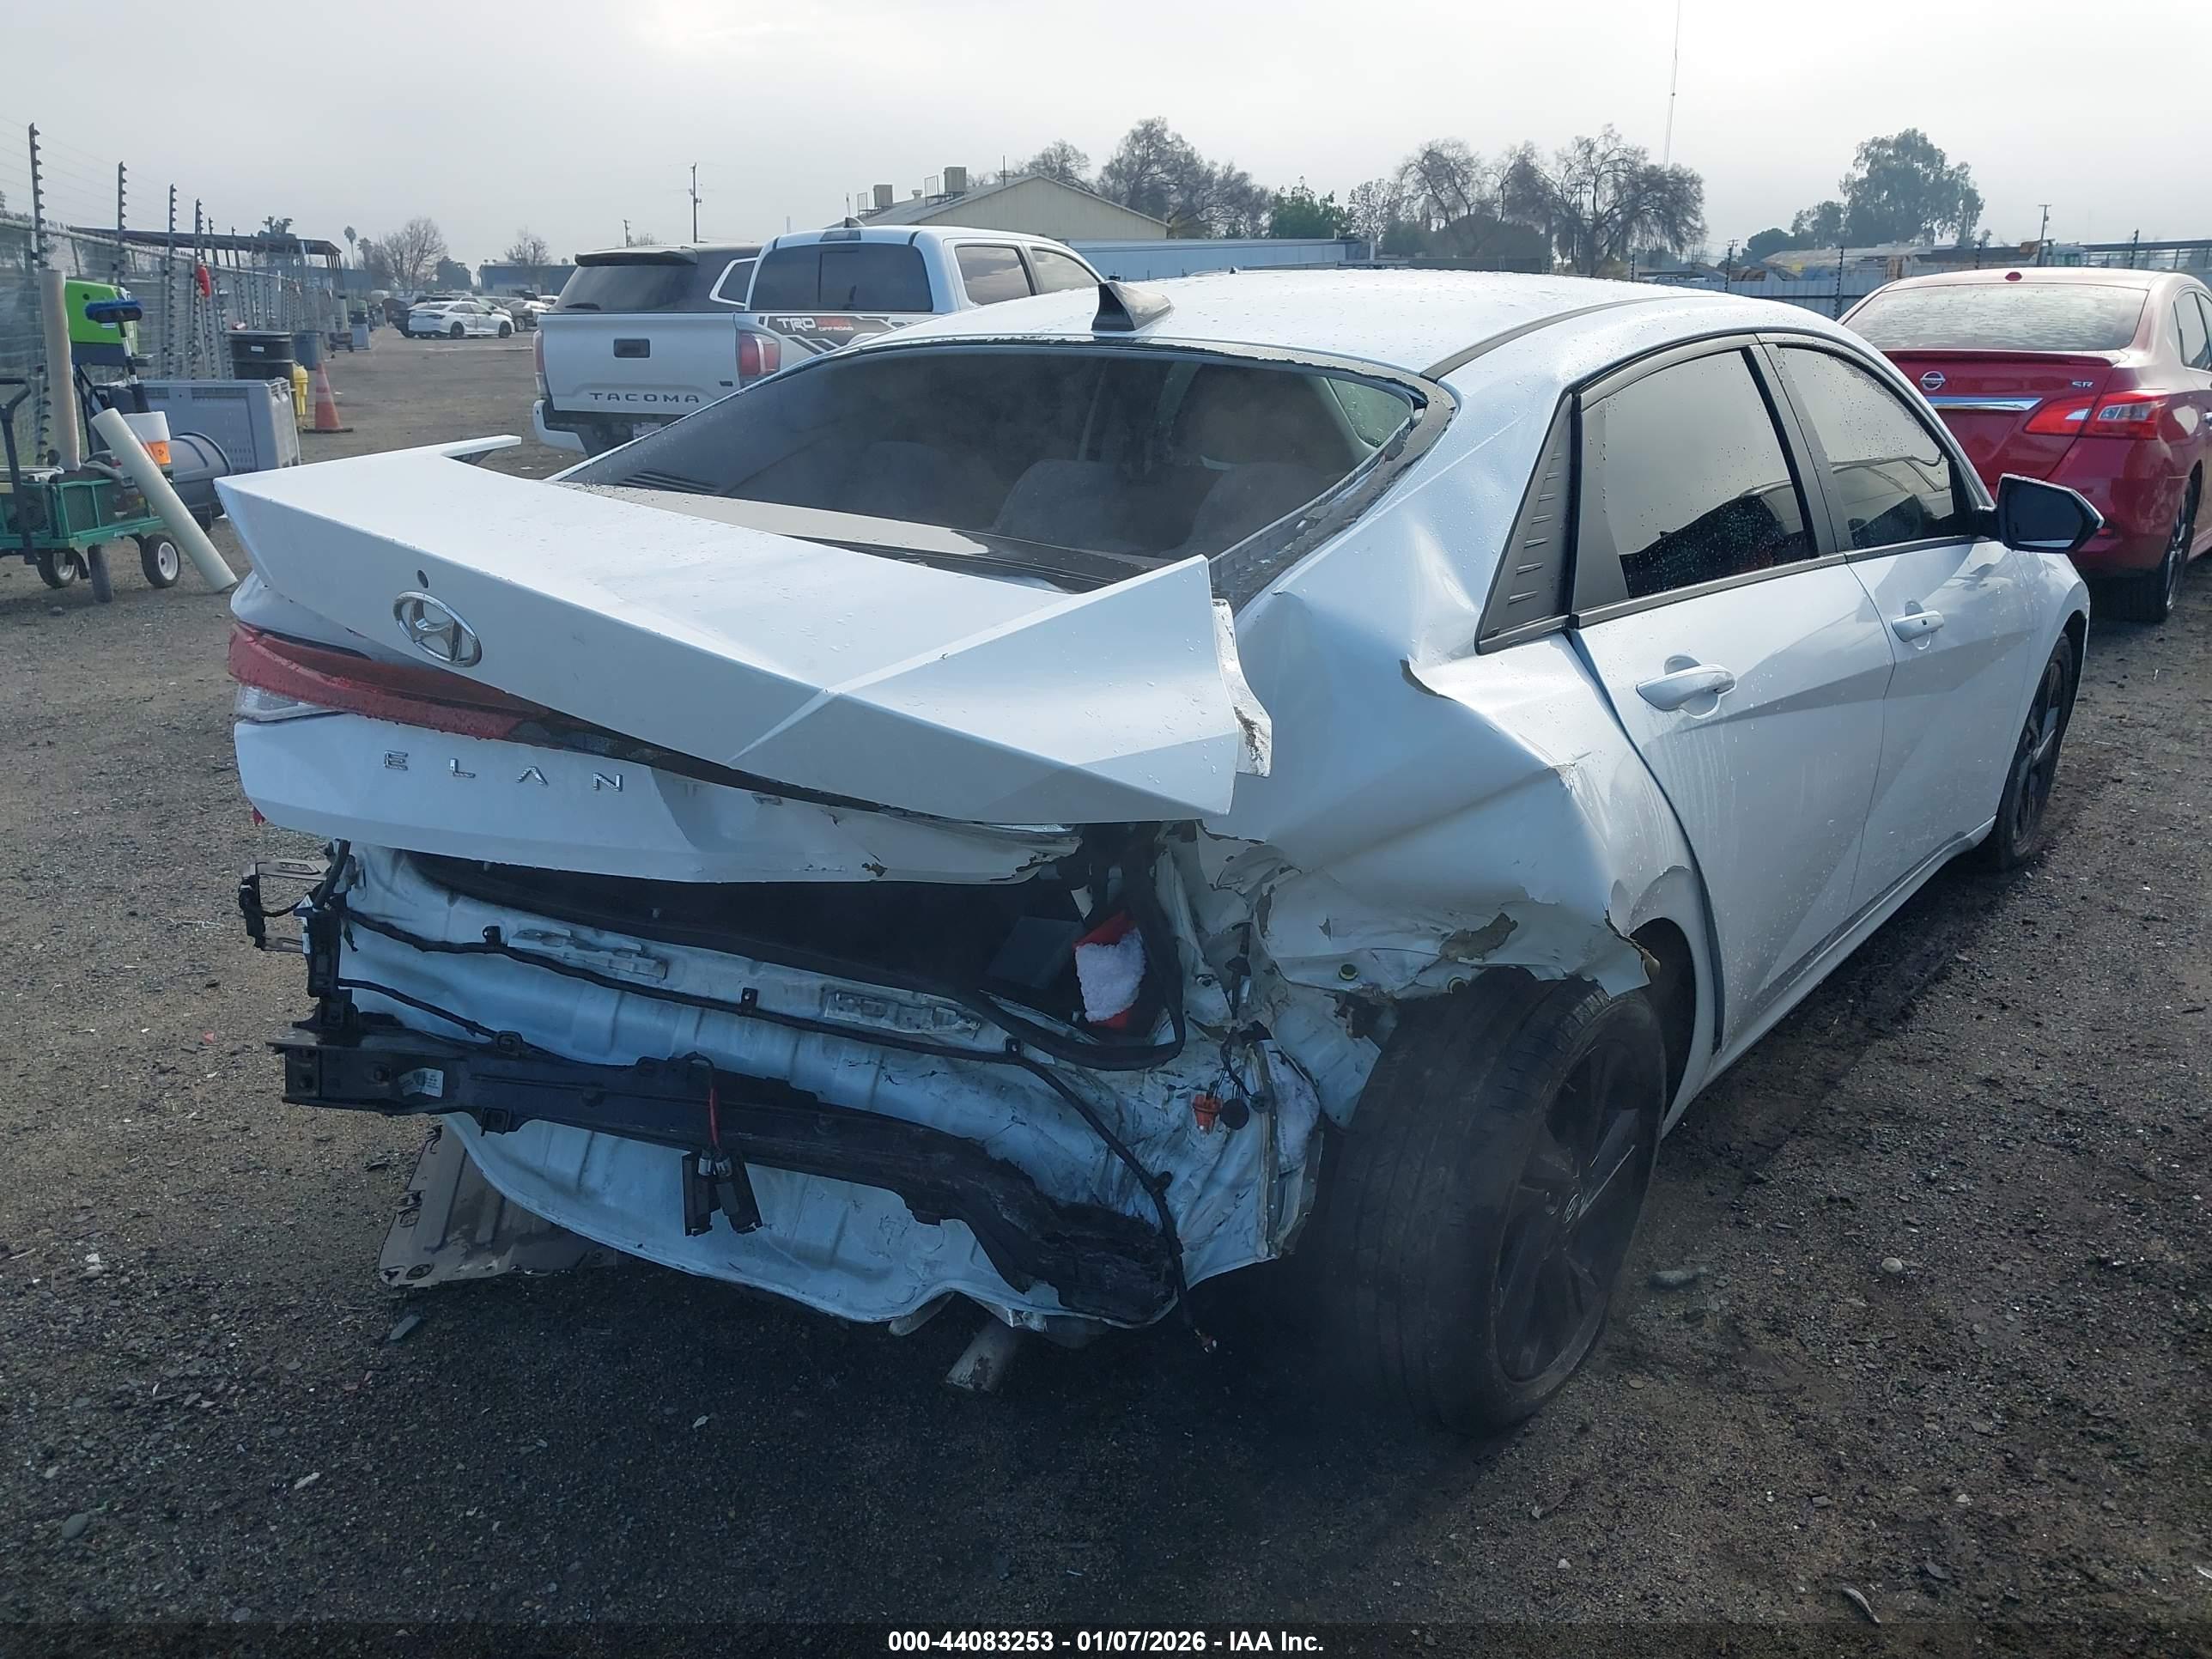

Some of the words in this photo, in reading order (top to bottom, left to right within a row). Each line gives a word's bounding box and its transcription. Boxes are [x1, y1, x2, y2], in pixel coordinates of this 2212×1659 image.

[776, 317, 816, 331] TRD
[589, 392, 700, 404] TACOMA
[384, 750, 623, 792] ELAN
